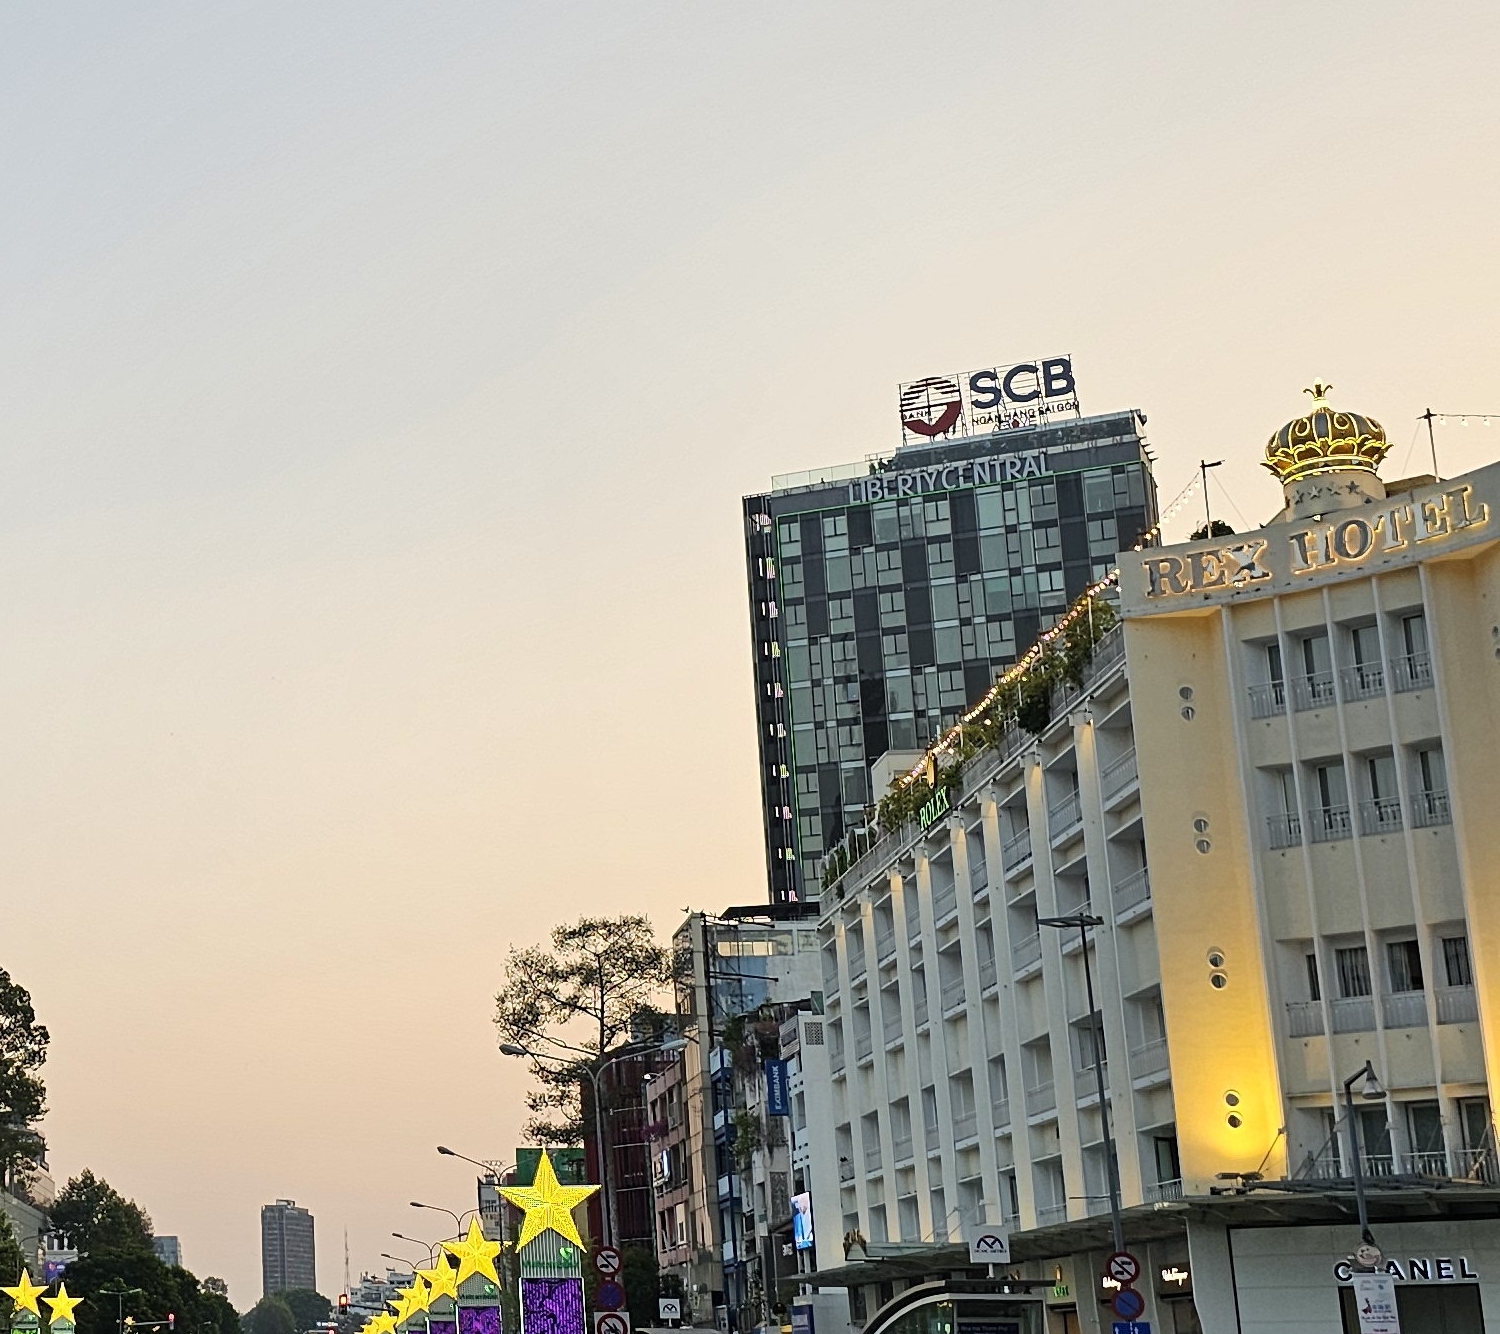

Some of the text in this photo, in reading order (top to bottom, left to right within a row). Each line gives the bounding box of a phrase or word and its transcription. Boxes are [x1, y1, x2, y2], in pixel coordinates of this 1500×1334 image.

[970, 358, 1076, 409] SCB
[1143, 485, 1490, 598] REX HOTEL
[919, 785, 950, 832] ROLEX
[772, 1065, 782, 1110] EXIMBANK
[1334, 1256, 1480, 1282] CANEL
